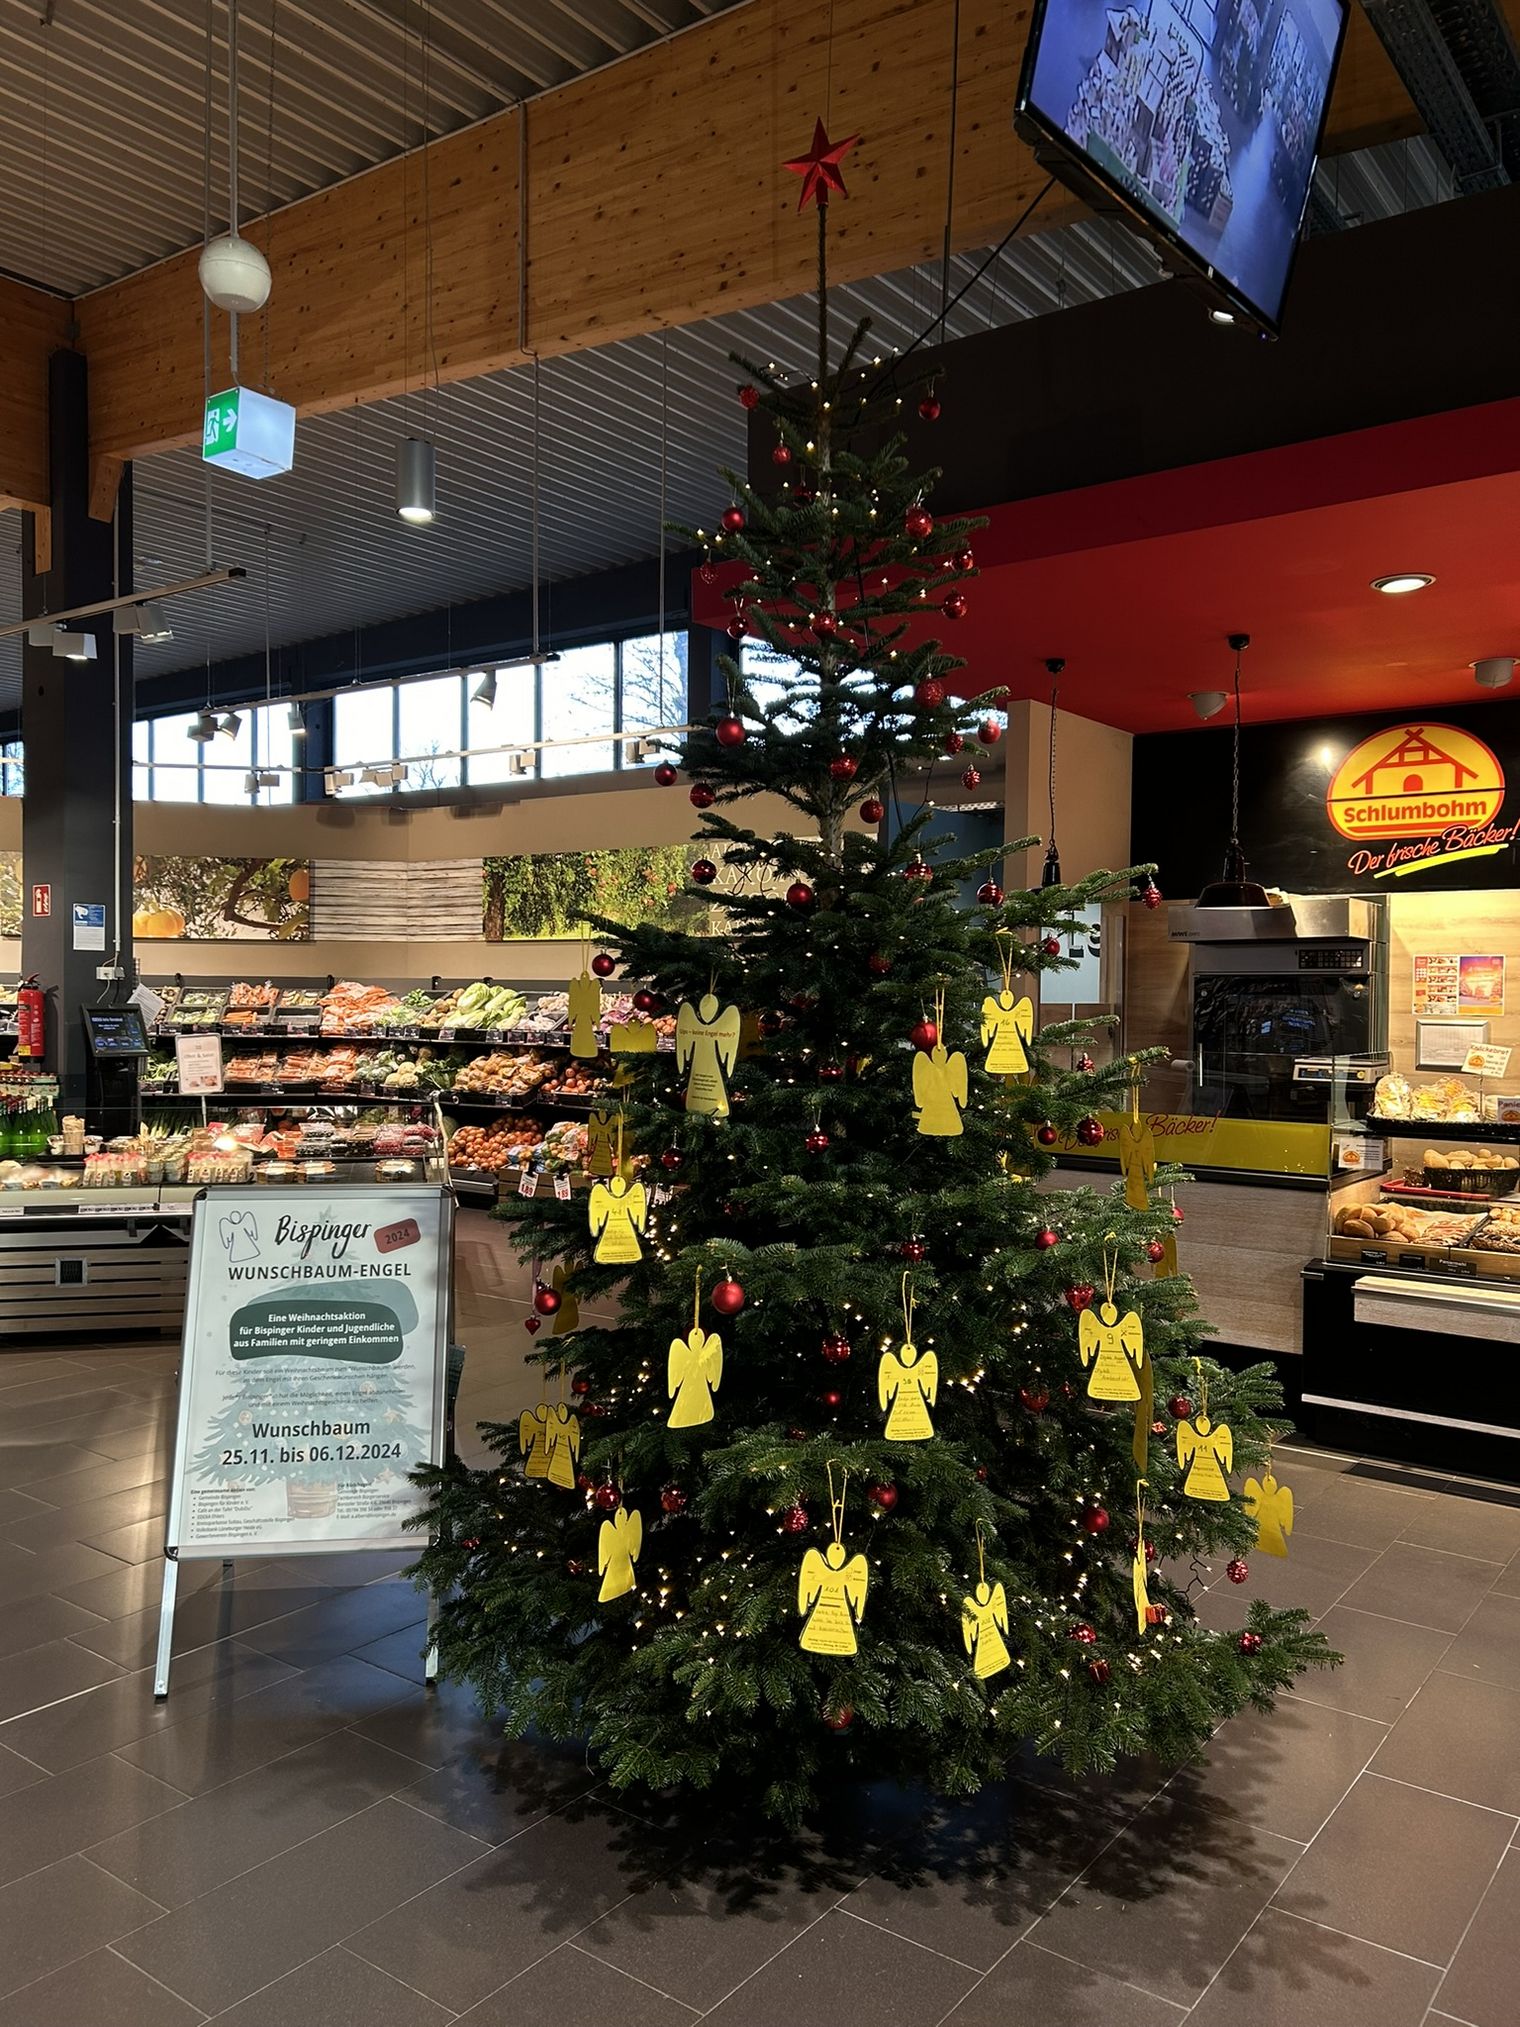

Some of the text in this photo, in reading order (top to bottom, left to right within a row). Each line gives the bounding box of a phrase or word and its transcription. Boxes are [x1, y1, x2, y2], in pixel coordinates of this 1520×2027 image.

[1344, 800, 1487, 823] Schlumbohm
[1347, 818, 1520, 875] Der frische Bäcker!
[1145, 1110, 1221, 1137] Bäcker!
[274, 1214, 373, 1259] Bispinger
[384, 1228, 410, 1245] 2024
[228, 1263, 412, 1281] WUNSCHBAUM-ENGEL
[268, 1311, 366, 1322] Eine Weihnachtsaktion
[239, 1322, 396, 1337] für Bispinger Kinder und Jugendliche
[233, 1334, 400, 1348] aus Familien mit geringem Einkommen
[252, 1420, 371, 1438] Wunschbaum
[222, 1443, 402, 1466] 25.11. bis 06.12.2024
